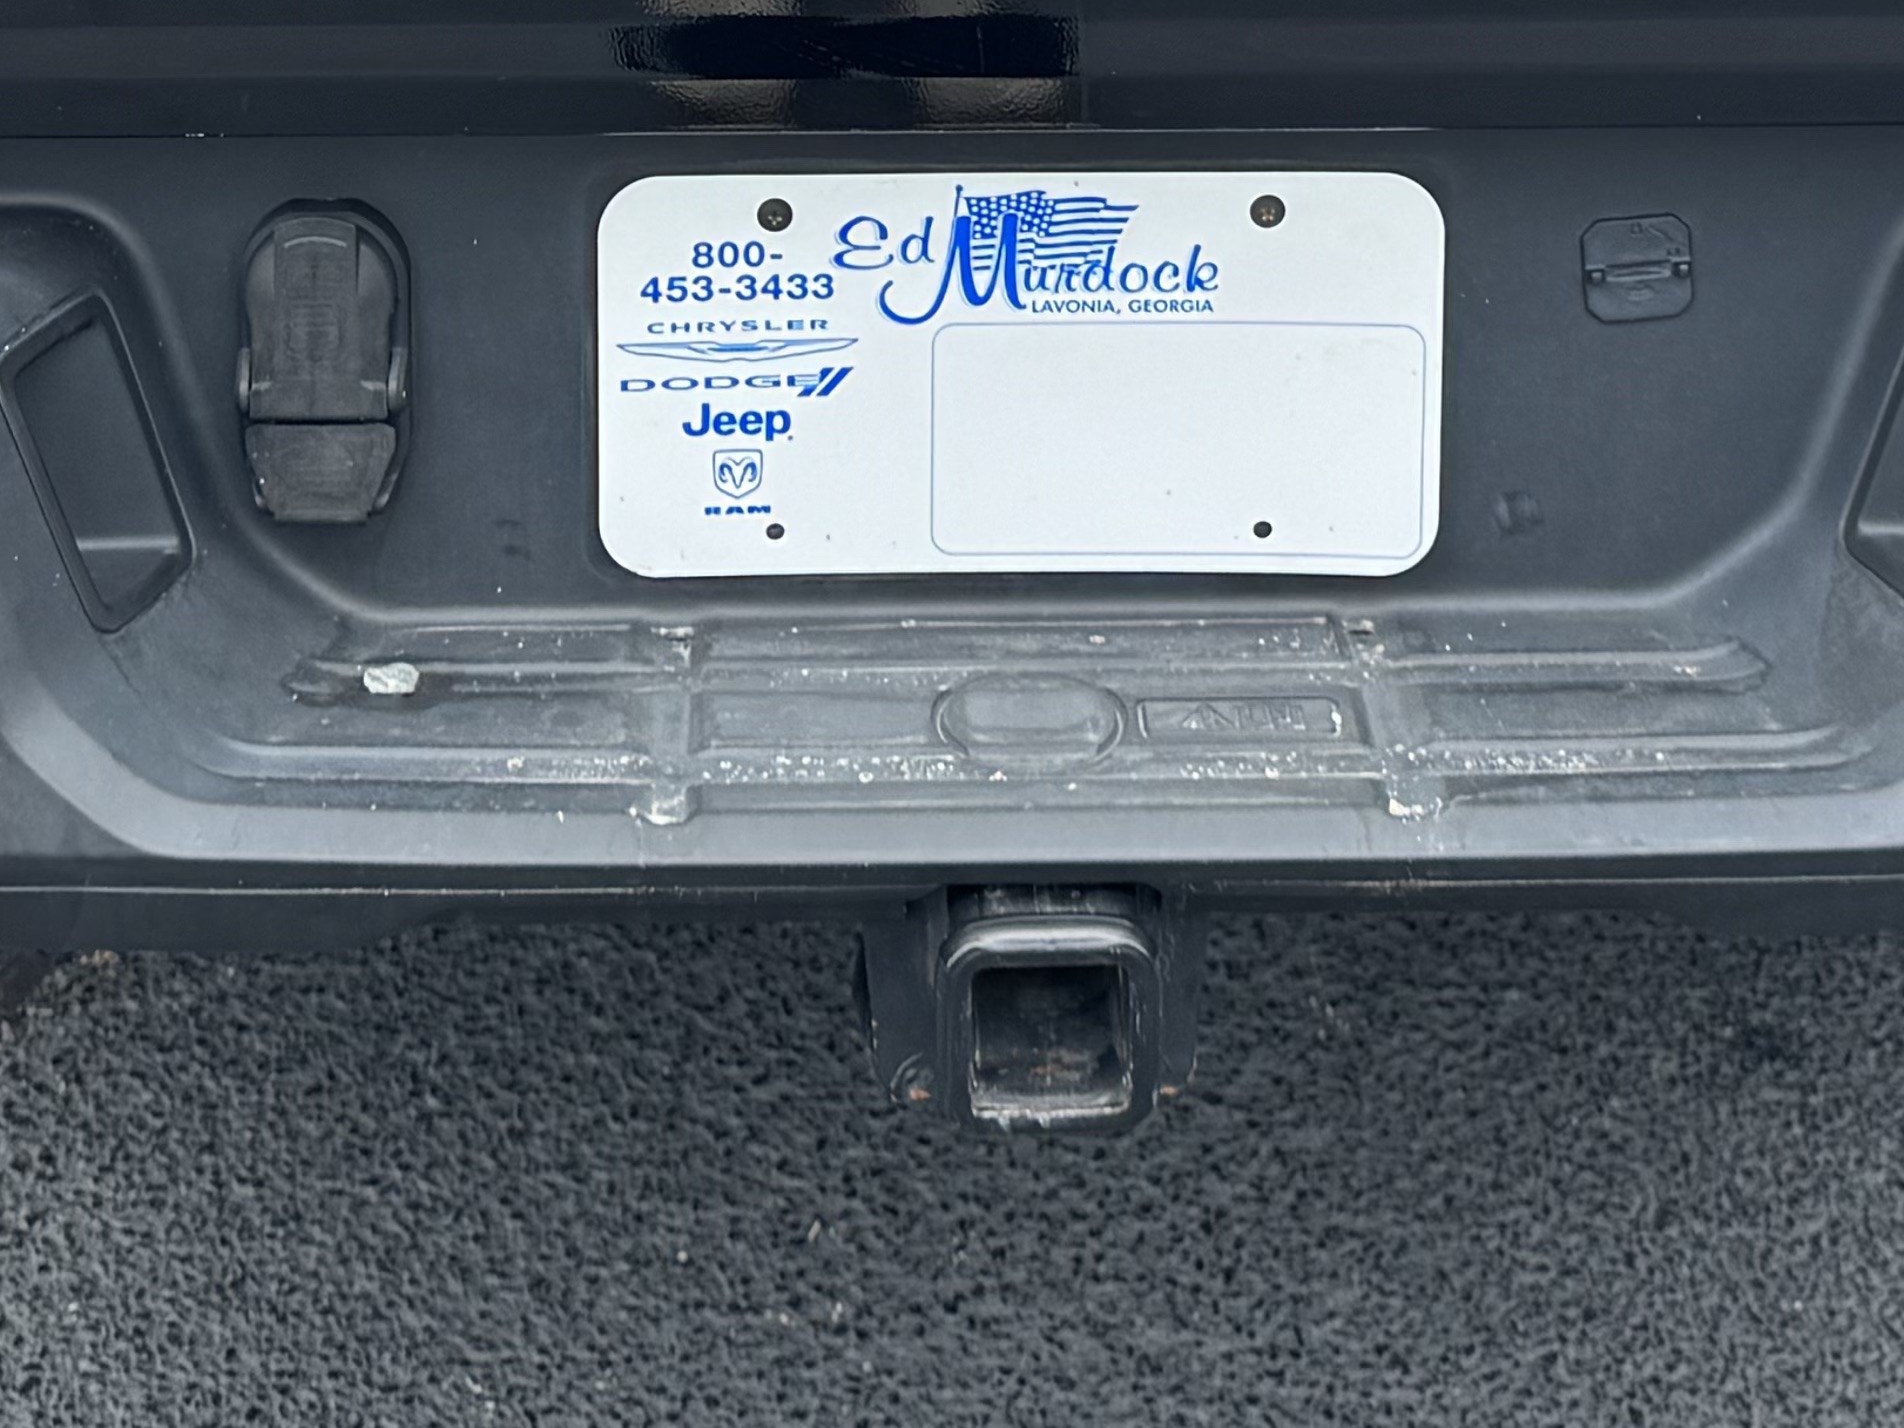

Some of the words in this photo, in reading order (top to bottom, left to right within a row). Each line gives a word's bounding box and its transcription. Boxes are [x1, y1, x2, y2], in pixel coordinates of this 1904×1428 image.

[691, 241, 784, 269] 800-
[831, 215, 935, 271] Ed
[878, 211, 1219, 325] Murdock
[640, 273, 835, 304] 453-3433
[1031, 298, 1122, 315] LAVONIA,
[1127, 297, 1215, 314] GEORGIA
[646, 318, 829, 335] CHRYSLER
[620, 373, 824, 393] DODGE
[682, 402, 793, 442] Jeep
[704, 504, 772, 516] RAM
